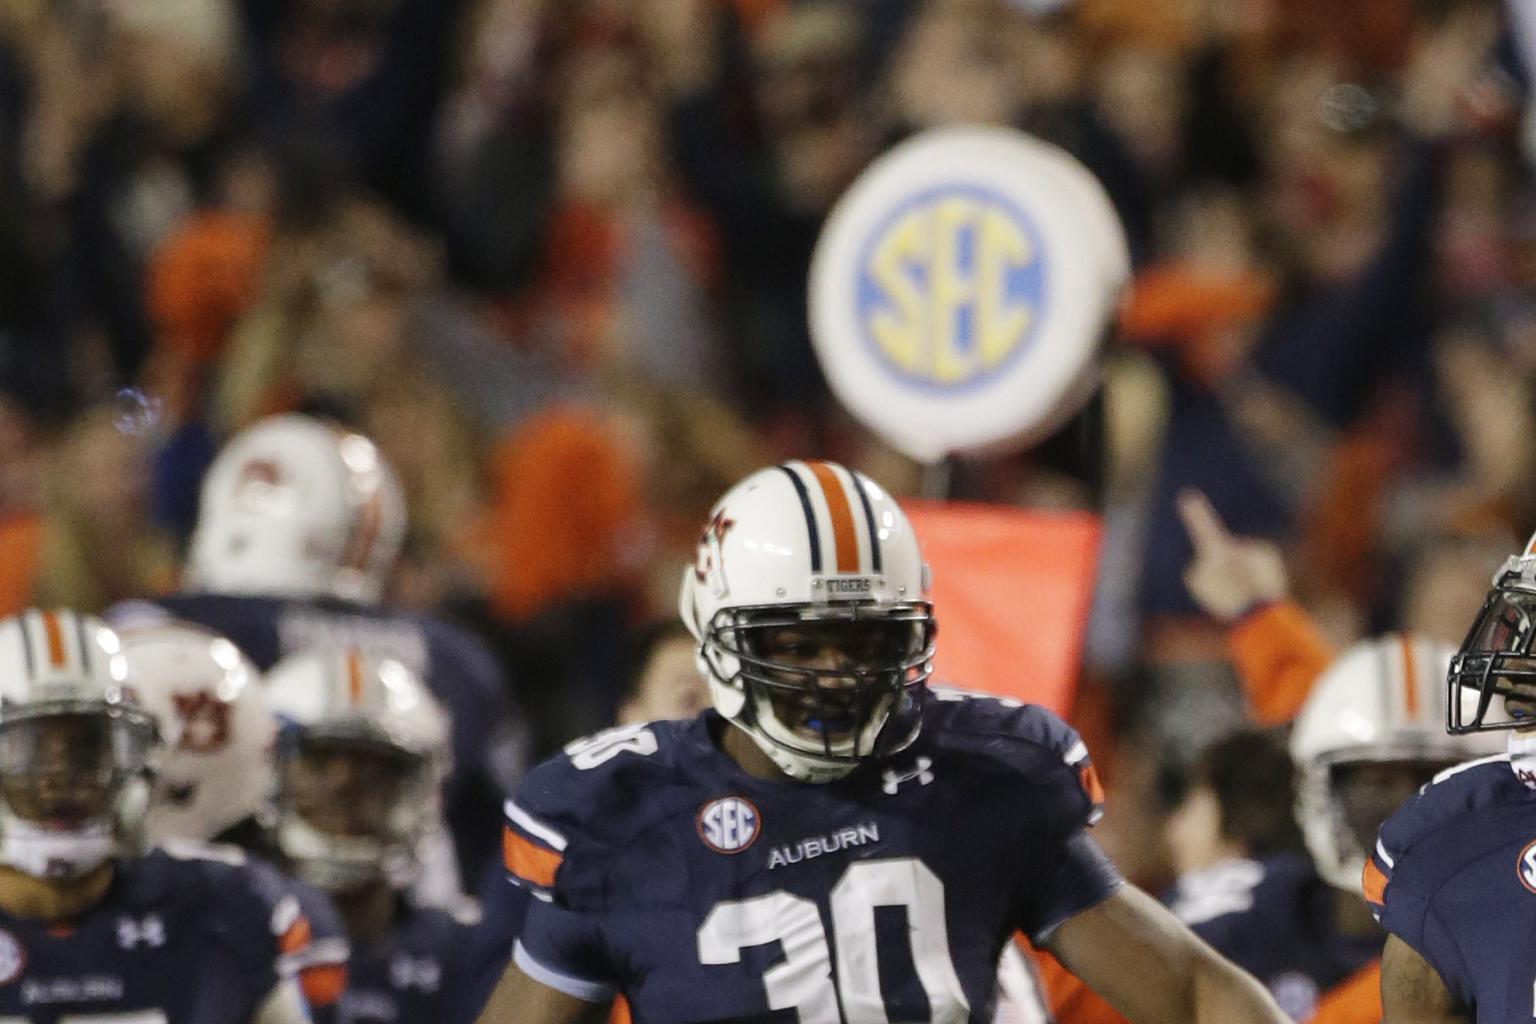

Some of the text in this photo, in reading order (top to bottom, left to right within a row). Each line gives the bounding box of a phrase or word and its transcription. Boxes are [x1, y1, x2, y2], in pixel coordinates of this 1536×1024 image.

[866, 200, 1030, 382] SEC
[826, 579, 872, 592] TIGERS
[702, 797, 756, 850] SEC
[768, 822, 880, 869] AUBURN
